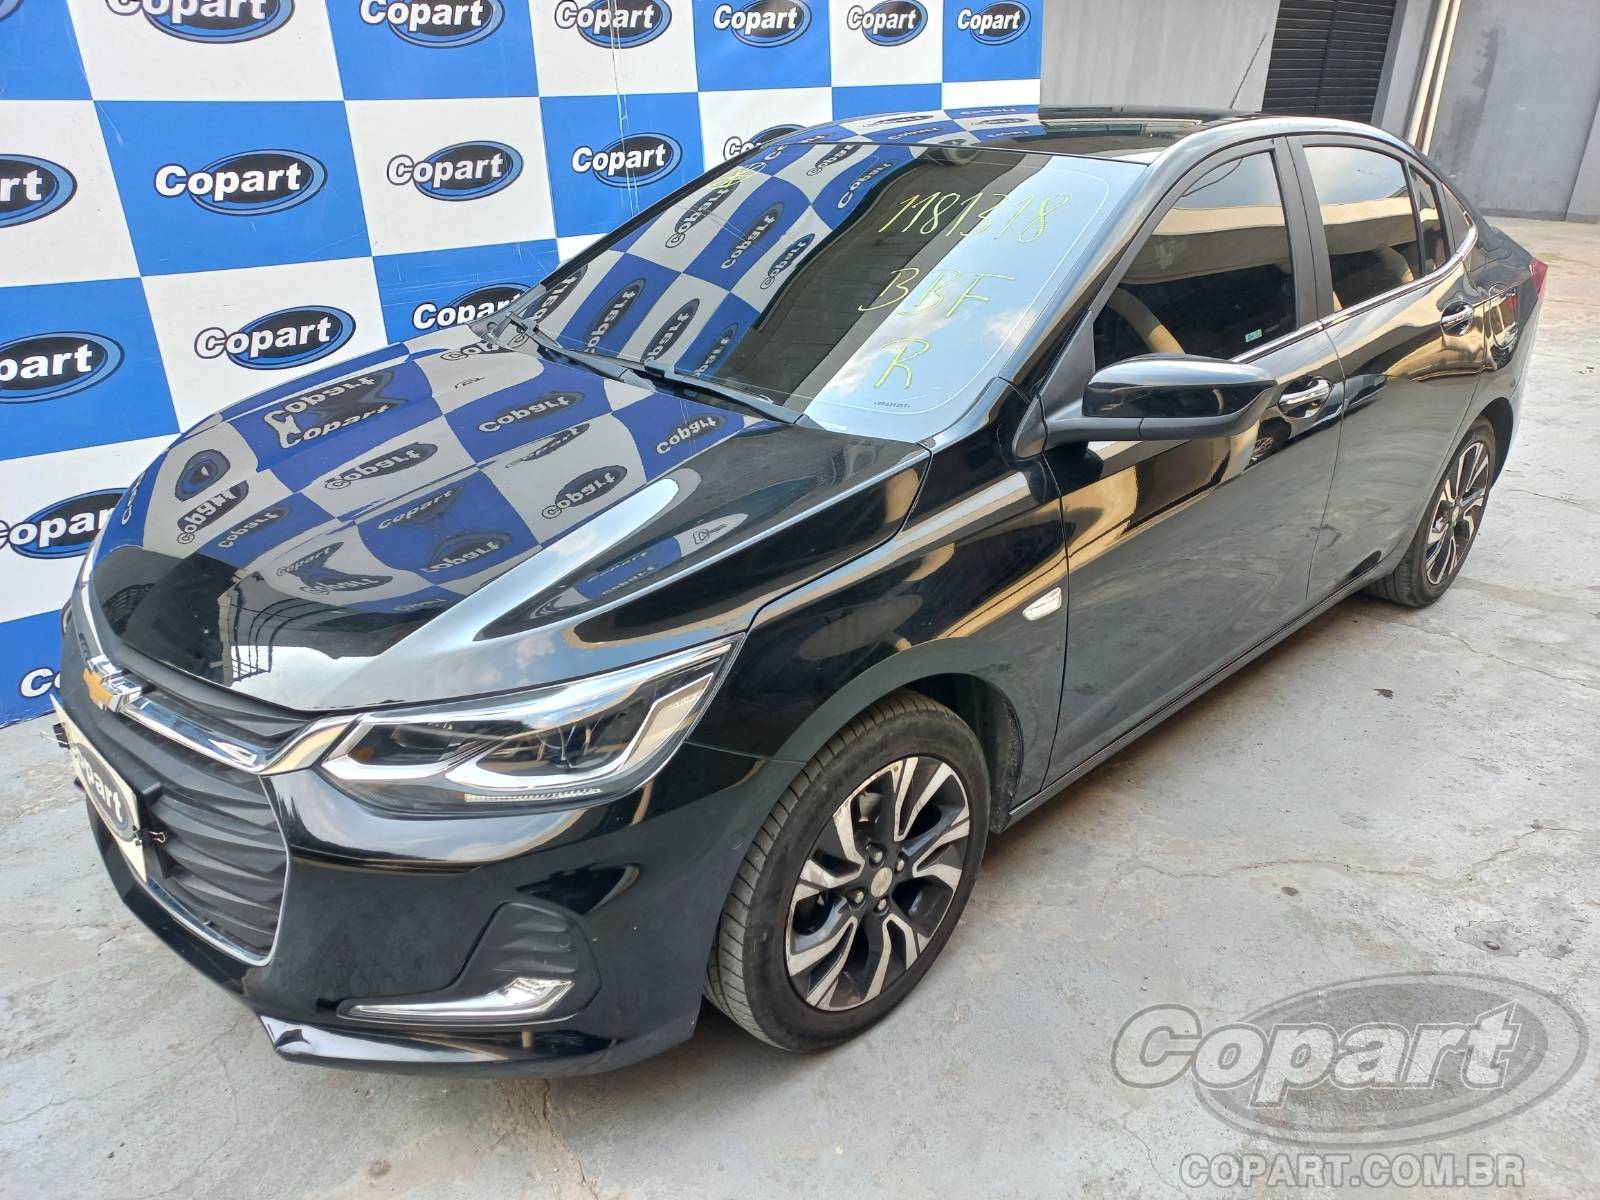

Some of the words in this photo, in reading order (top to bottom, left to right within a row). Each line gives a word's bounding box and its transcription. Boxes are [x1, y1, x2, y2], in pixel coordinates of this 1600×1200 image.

[359, 0, 483, 31] Copart
[555, 1, 655, 34] Copart
[713, 4, 798, 35] Copart
[848, 6, 917, 34] Copart
[957, 8, 1020, 34] Copart
[388, 153, 504, 188] Copart
[572, 143, 666, 177] Copart
[155, 162, 302, 202] Copart
[878, 191, 1070, 243] 1181318
[858, 267, 1016, 318] BBF
[195, 316, 332, 359] Copart
[874, 336, 944, 390] R
